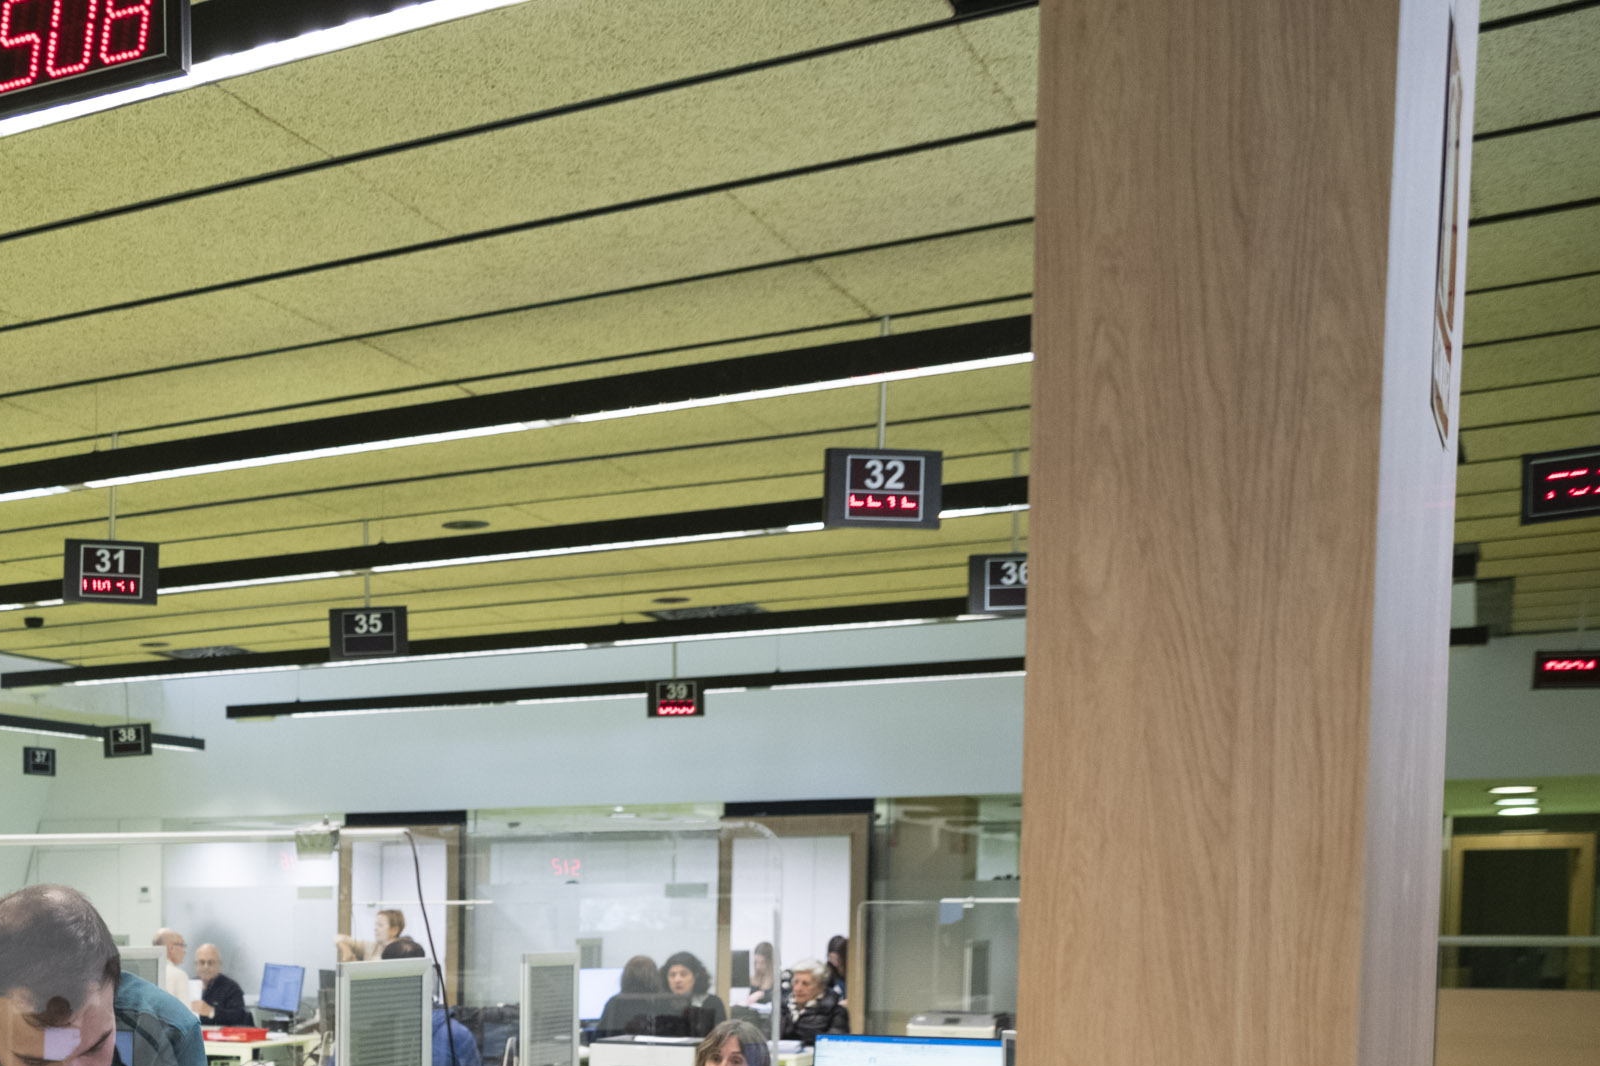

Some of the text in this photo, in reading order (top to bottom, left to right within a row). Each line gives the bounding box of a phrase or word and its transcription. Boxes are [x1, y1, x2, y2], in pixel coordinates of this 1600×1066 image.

[864, 459, 905, 490] 32
[95, 549, 125, 574] 31
[354, 613, 383, 634] 35
[666, 682, 688, 700] 39
[118, 727, 137, 743] 38
[34, 749, 48, 763] 37
